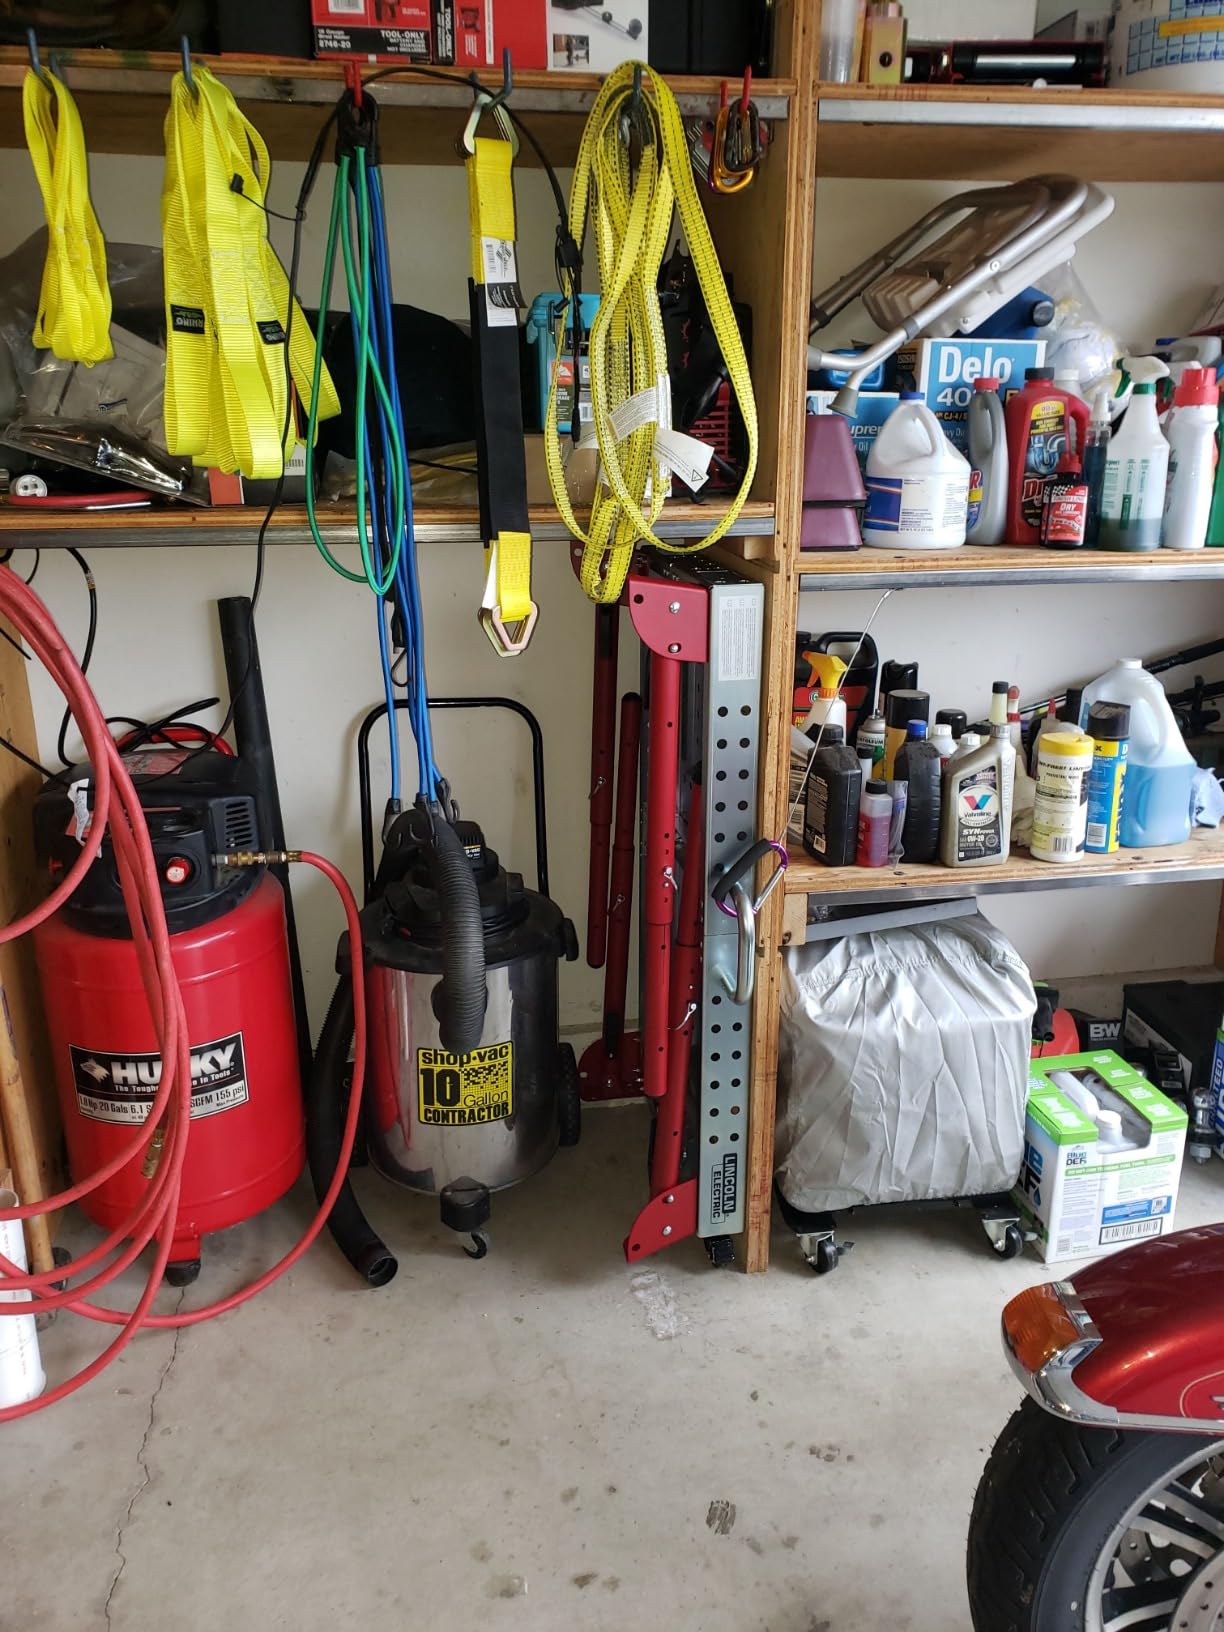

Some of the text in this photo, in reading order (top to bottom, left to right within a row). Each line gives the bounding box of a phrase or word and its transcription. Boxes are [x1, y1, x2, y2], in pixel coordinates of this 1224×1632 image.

[380, 29, 425, 39] TOOL-ONLY
[938, 345, 1012, 384] Delo
[936, 387, 973, 408] 40
[1060, 502, 1077, 511] DRY
[111, 1042, 236, 1086] HUKY
[210, 1070, 231, 1081] Tools
[110, 1102, 129, 1114] Gals
[130, 1104, 143, 1115] 6.1
[215, 1089, 231, 1102] 155
[232, 1082, 244, 1098] psi
[420, 1067, 461, 1107] 10
[463, 1090, 509, 1108] Gallon
[423, 1101, 509, 1124] CONTRACTOR
[712, 1170, 722, 1219] ELECTRIC
[723, 1155, 736, 1212] LINCOLN
